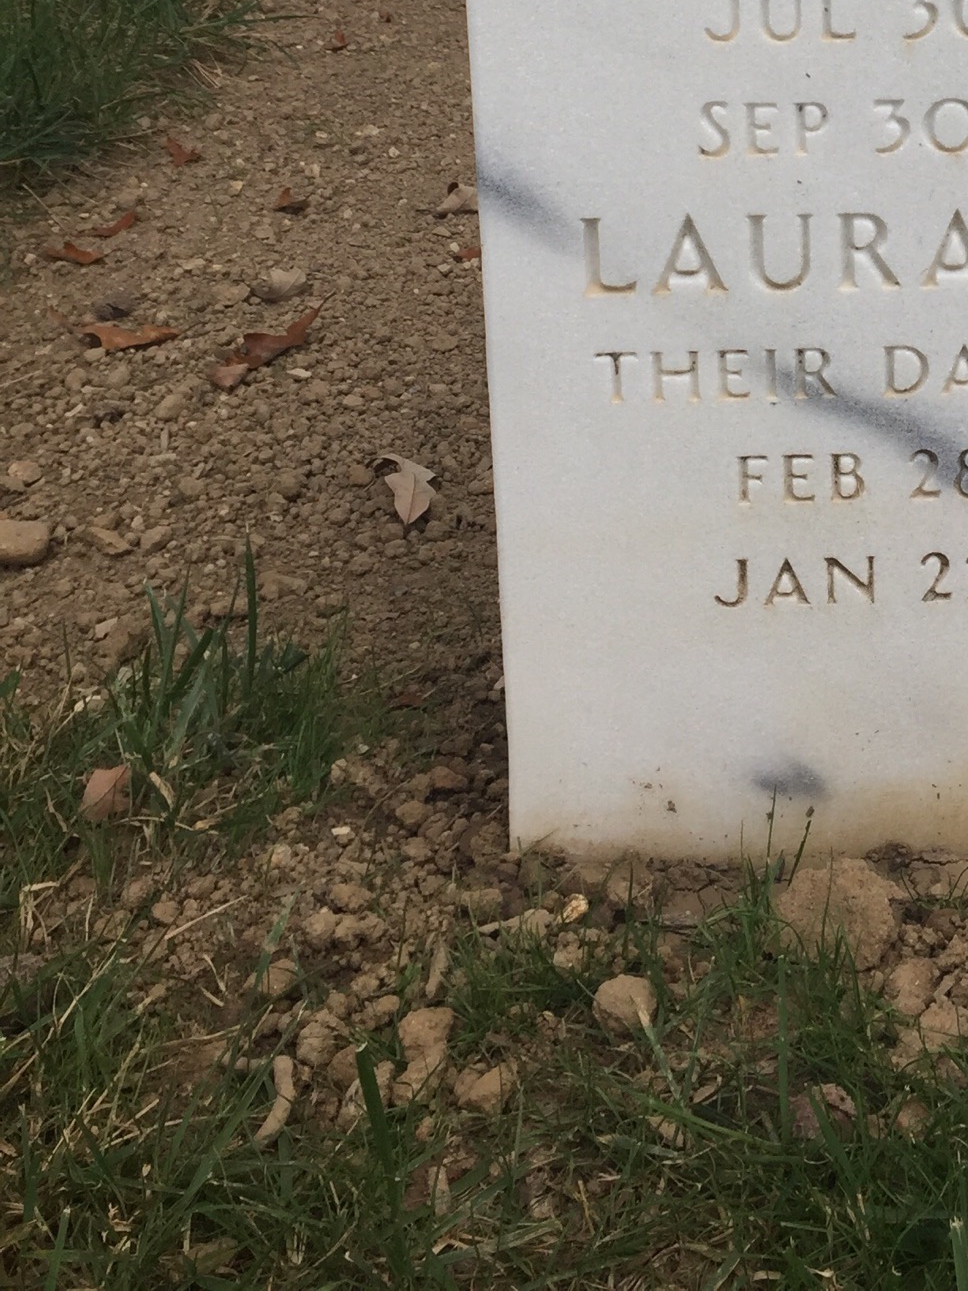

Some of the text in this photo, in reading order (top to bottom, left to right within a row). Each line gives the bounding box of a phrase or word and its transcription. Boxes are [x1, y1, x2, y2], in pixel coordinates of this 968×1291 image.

[699, 99, 830, 159] SEP
[596, 346, 838, 403] THEIR
[737, 453, 868, 504] FEB
[714, 556, 876, 609] JAN
